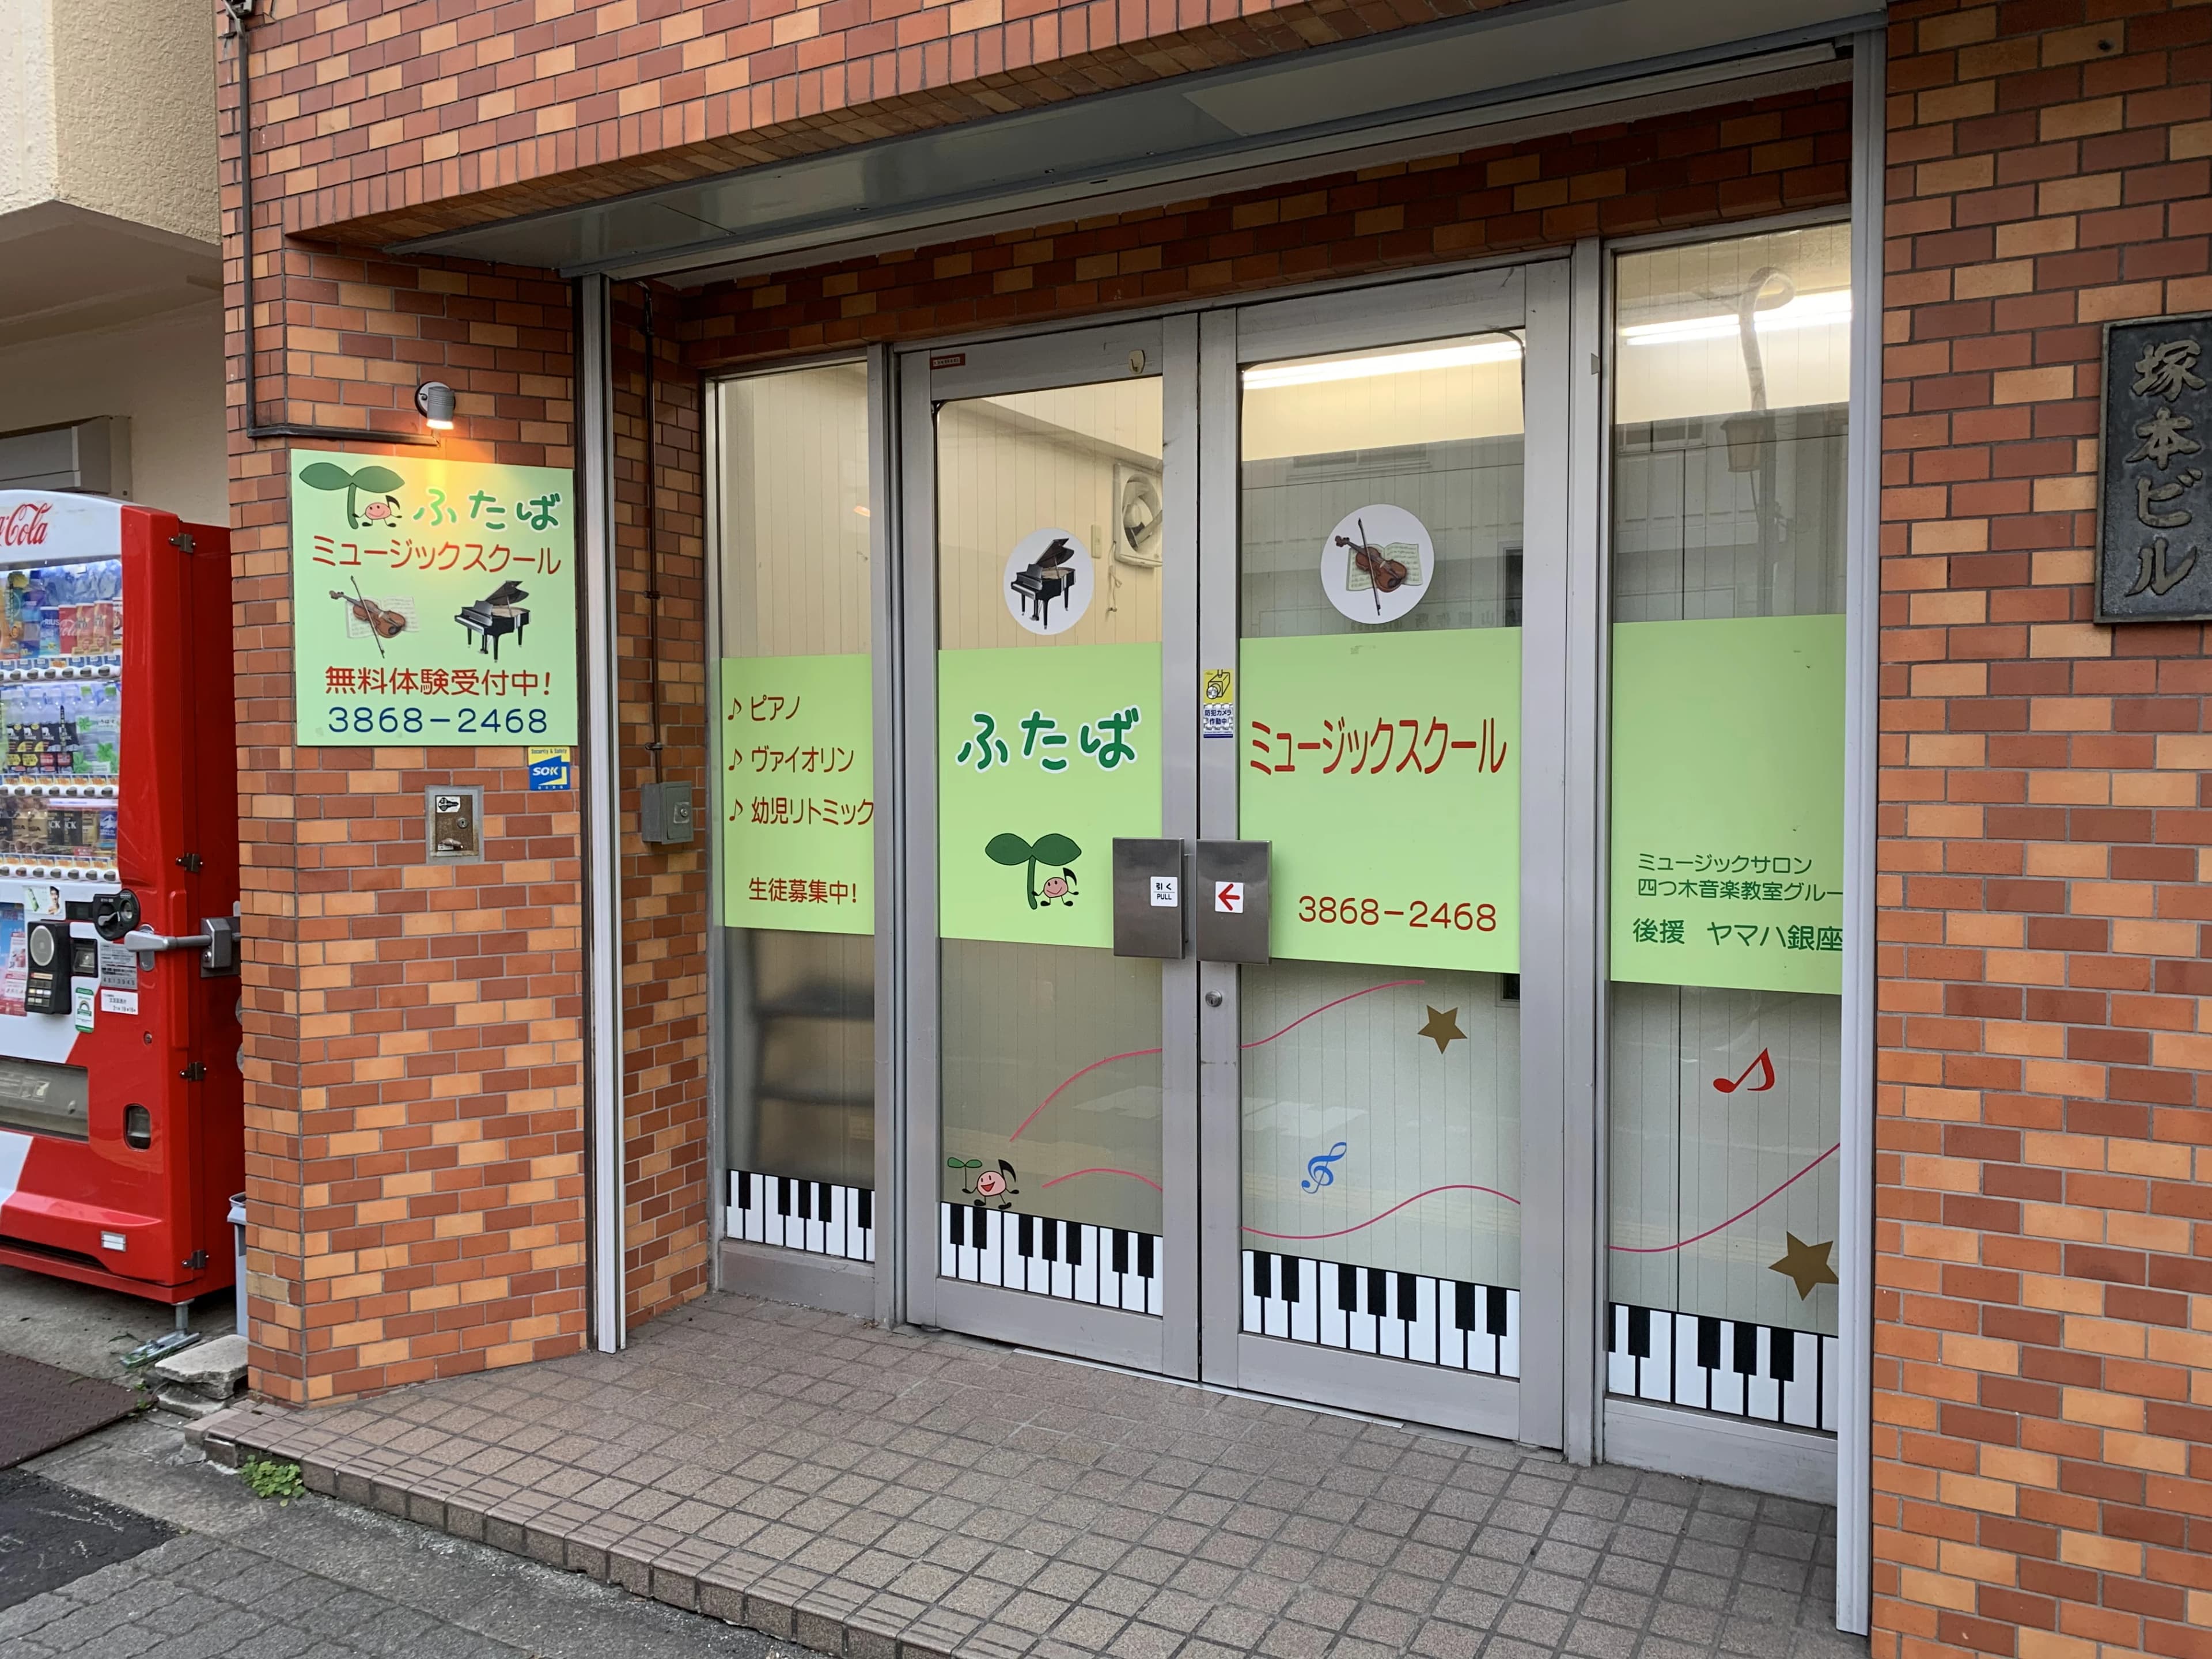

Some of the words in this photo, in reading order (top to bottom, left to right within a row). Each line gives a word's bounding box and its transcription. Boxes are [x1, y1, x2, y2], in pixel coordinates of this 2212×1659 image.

[2124, 340, 2207, 597] 塚本ビル
[412, 488, 561, 531] ふたば
[312, 535, 562, 574] ミュージックスクール
[325, 666, 551, 696] 無料体験受付中!
[328, 707, 547, 733] 3868-2468
[751, 694, 800, 721] ピアノ
[957, 708, 1139, 770] ふたば
[1250, 716, 1507, 775] ミュージックスクール
[532, 766, 559, 776] SOK
[751, 745, 854, 773] ヴァイオリン
[751, 796, 874, 825] 幼児リトミック
[1638, 853, 1812, 874] ミュージックサロン
[749, 877, 857, 905] 生徒募集中!
[1156, 882, 1172, 891] 引く
[1298, 895, 1497, 931] 3868-2468
[1633, 918, 1685, 944] 後援
[1707, 922, 1843, 951] ヤマハ銀座
